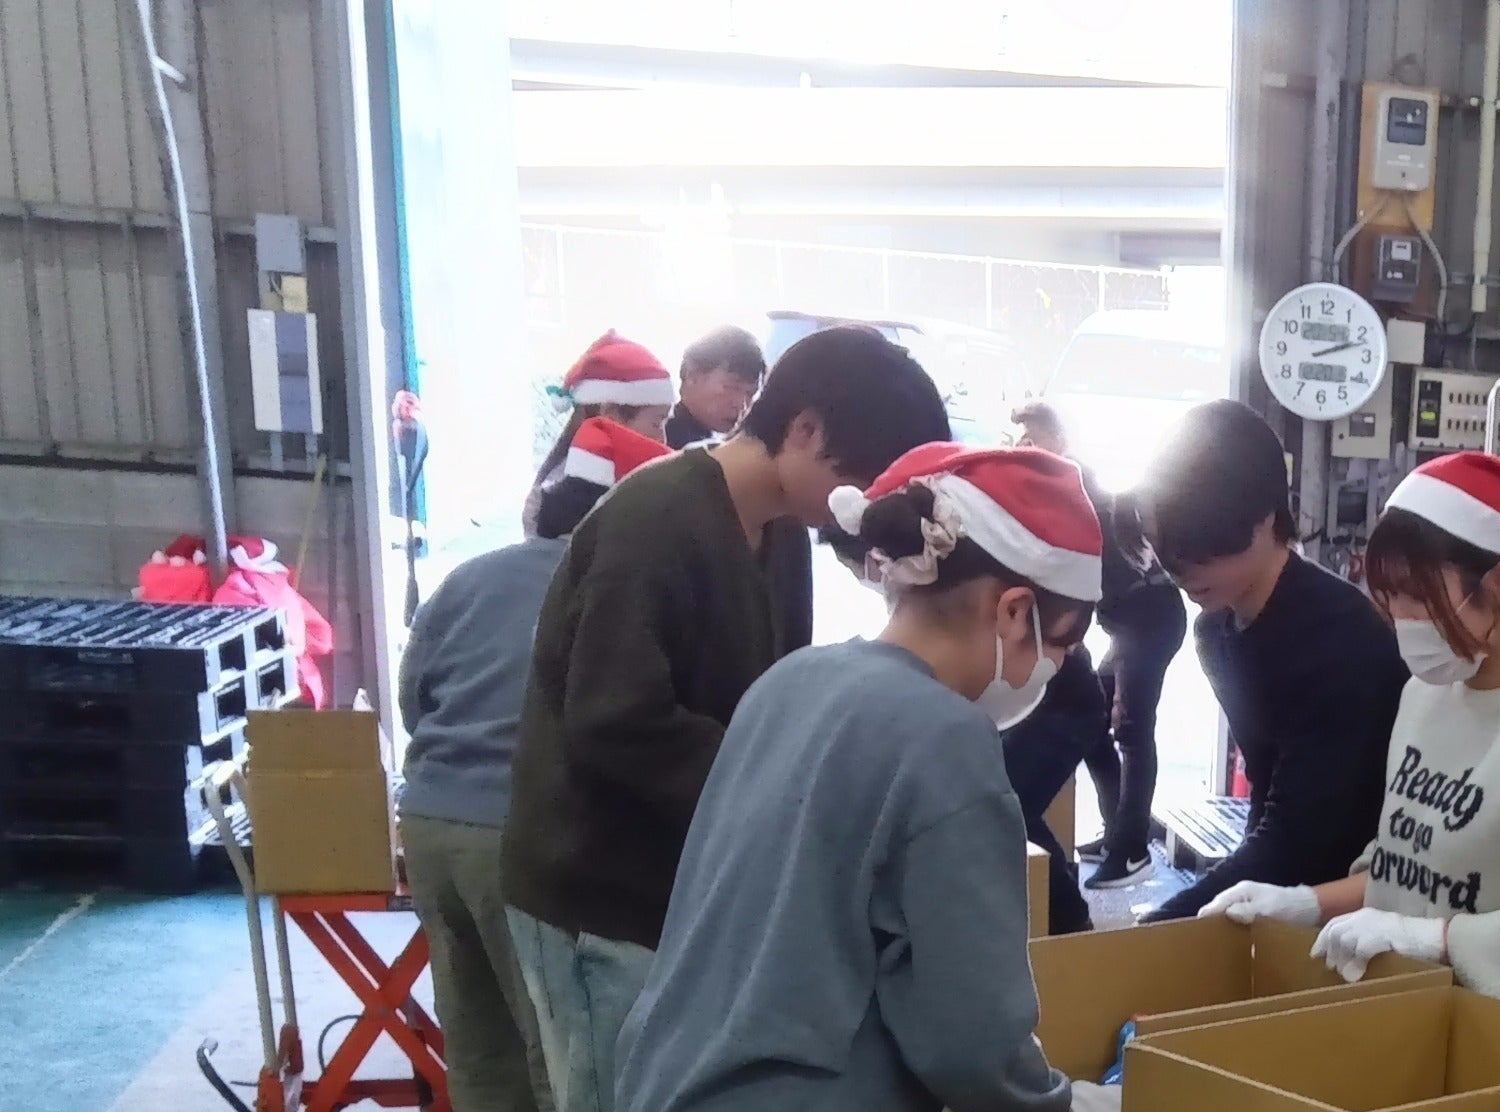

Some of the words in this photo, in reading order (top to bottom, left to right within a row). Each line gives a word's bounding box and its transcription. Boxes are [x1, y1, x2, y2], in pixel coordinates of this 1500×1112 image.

[1302, 304, 1311, 320] 11
[1321, 299, 1335, 316] 12
[1346, 308, 1351, 324] 1
[1284, 319, 1298, 335] 10
[1357, 326, 1367, 342] 2
[1277, 340, 1287, 356] 9
[1361, 349, 1372, 365] 3
[1281, 363, 1292, 380] 8
[1296, 381, 1305, 397] 7
[1316, 389, 1327, 405] 6
[1337, 385, 1348, 400] 5
[1389, 744, 1483, 832] Ready
[1371, 846, 1481, 914] orward
